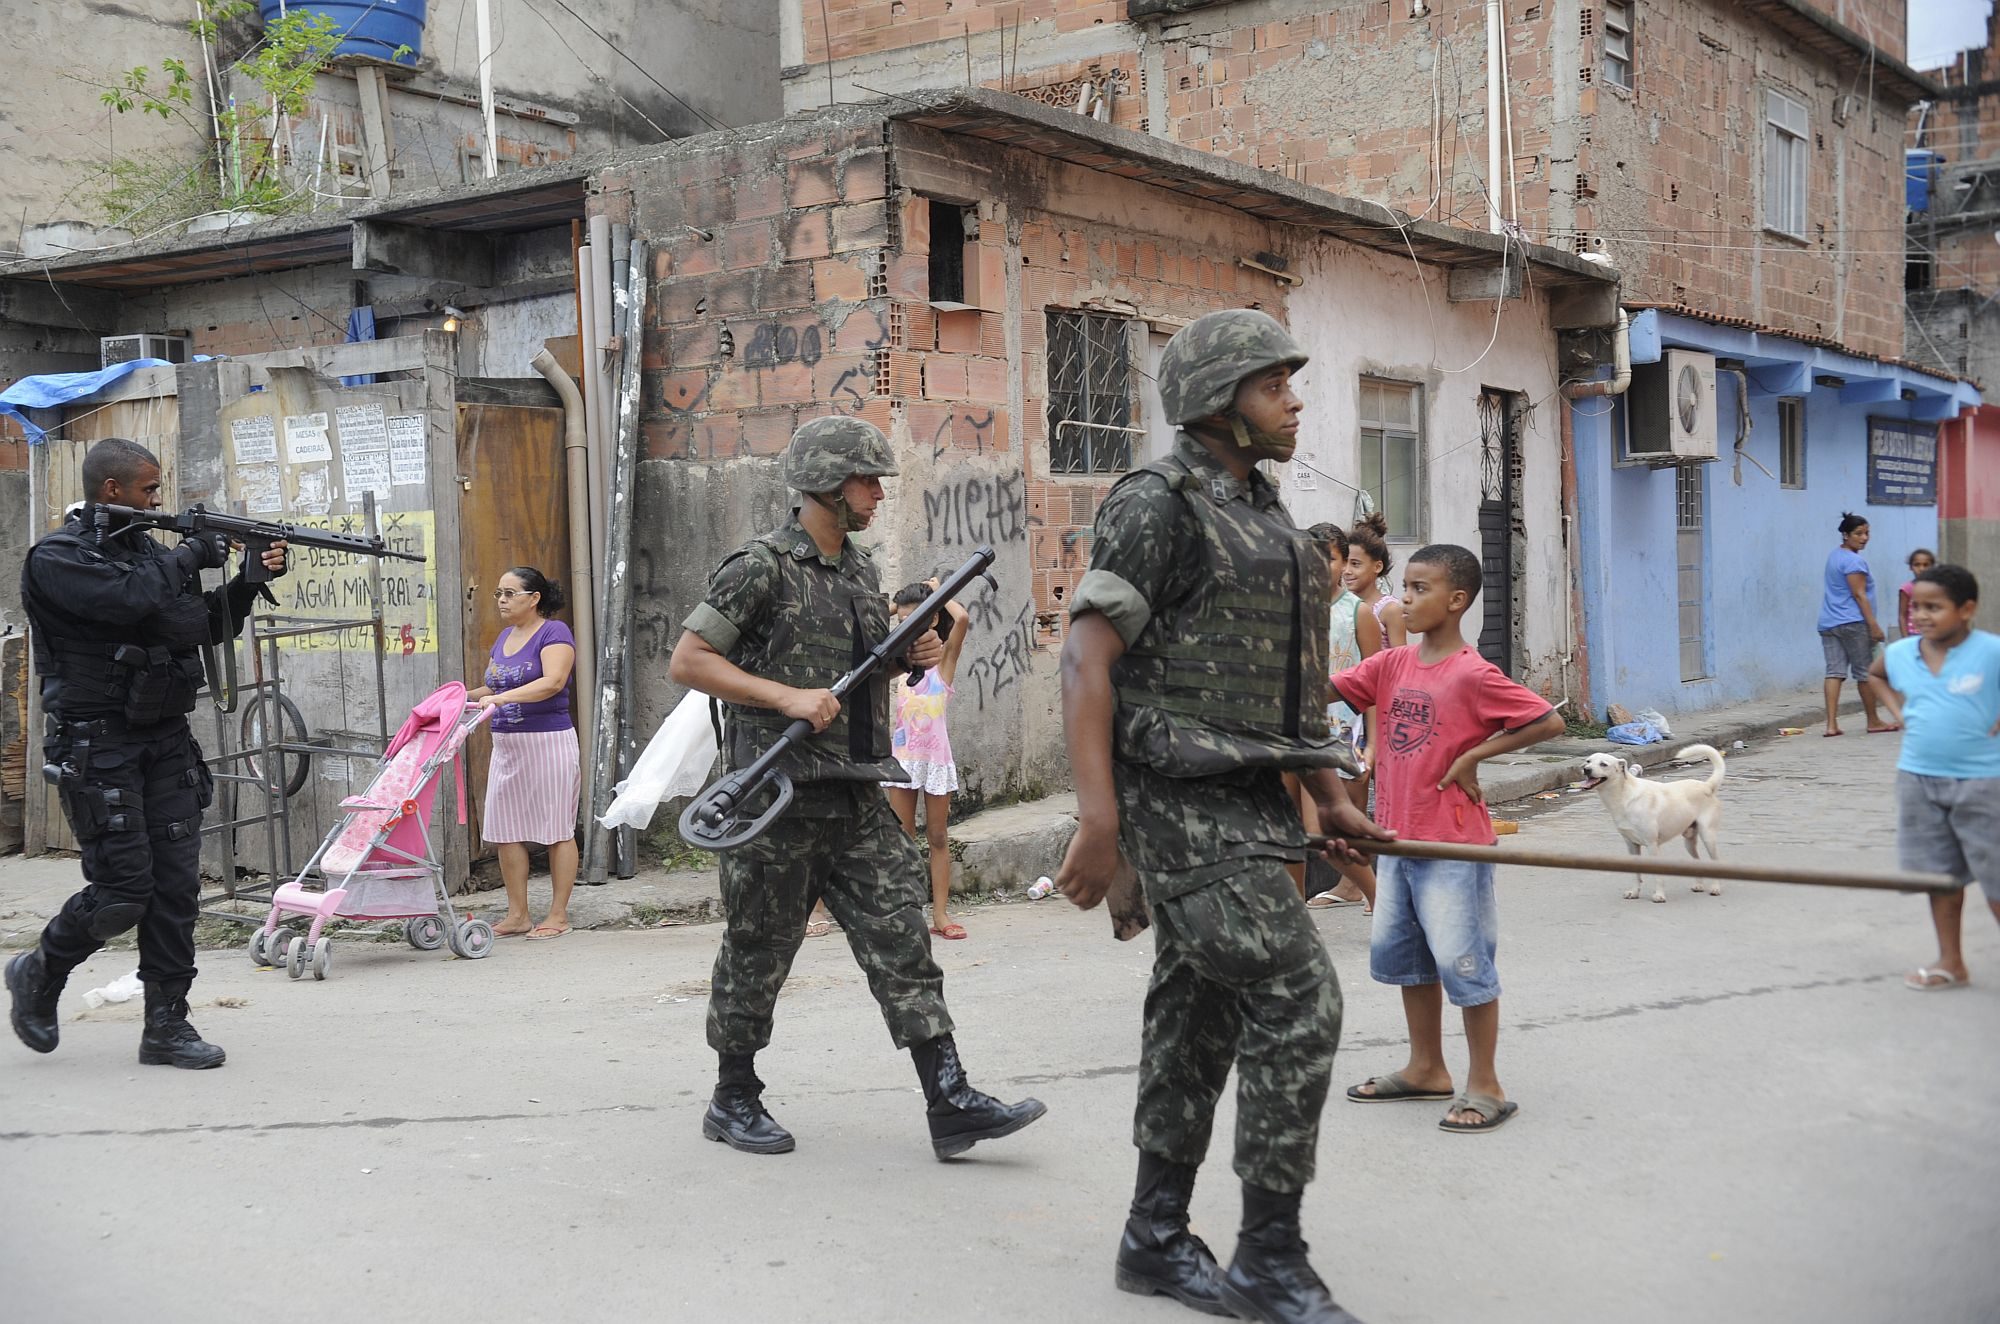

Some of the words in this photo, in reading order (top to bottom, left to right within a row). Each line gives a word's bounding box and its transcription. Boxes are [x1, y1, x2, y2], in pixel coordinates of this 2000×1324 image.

[295, 444, 325, 454] CADEIRAS
[1392, 697, 1430, 713] BATTLE
[1390, 707, 1430, 724] FORCE
[1392, 722, 1409, 744] 5
